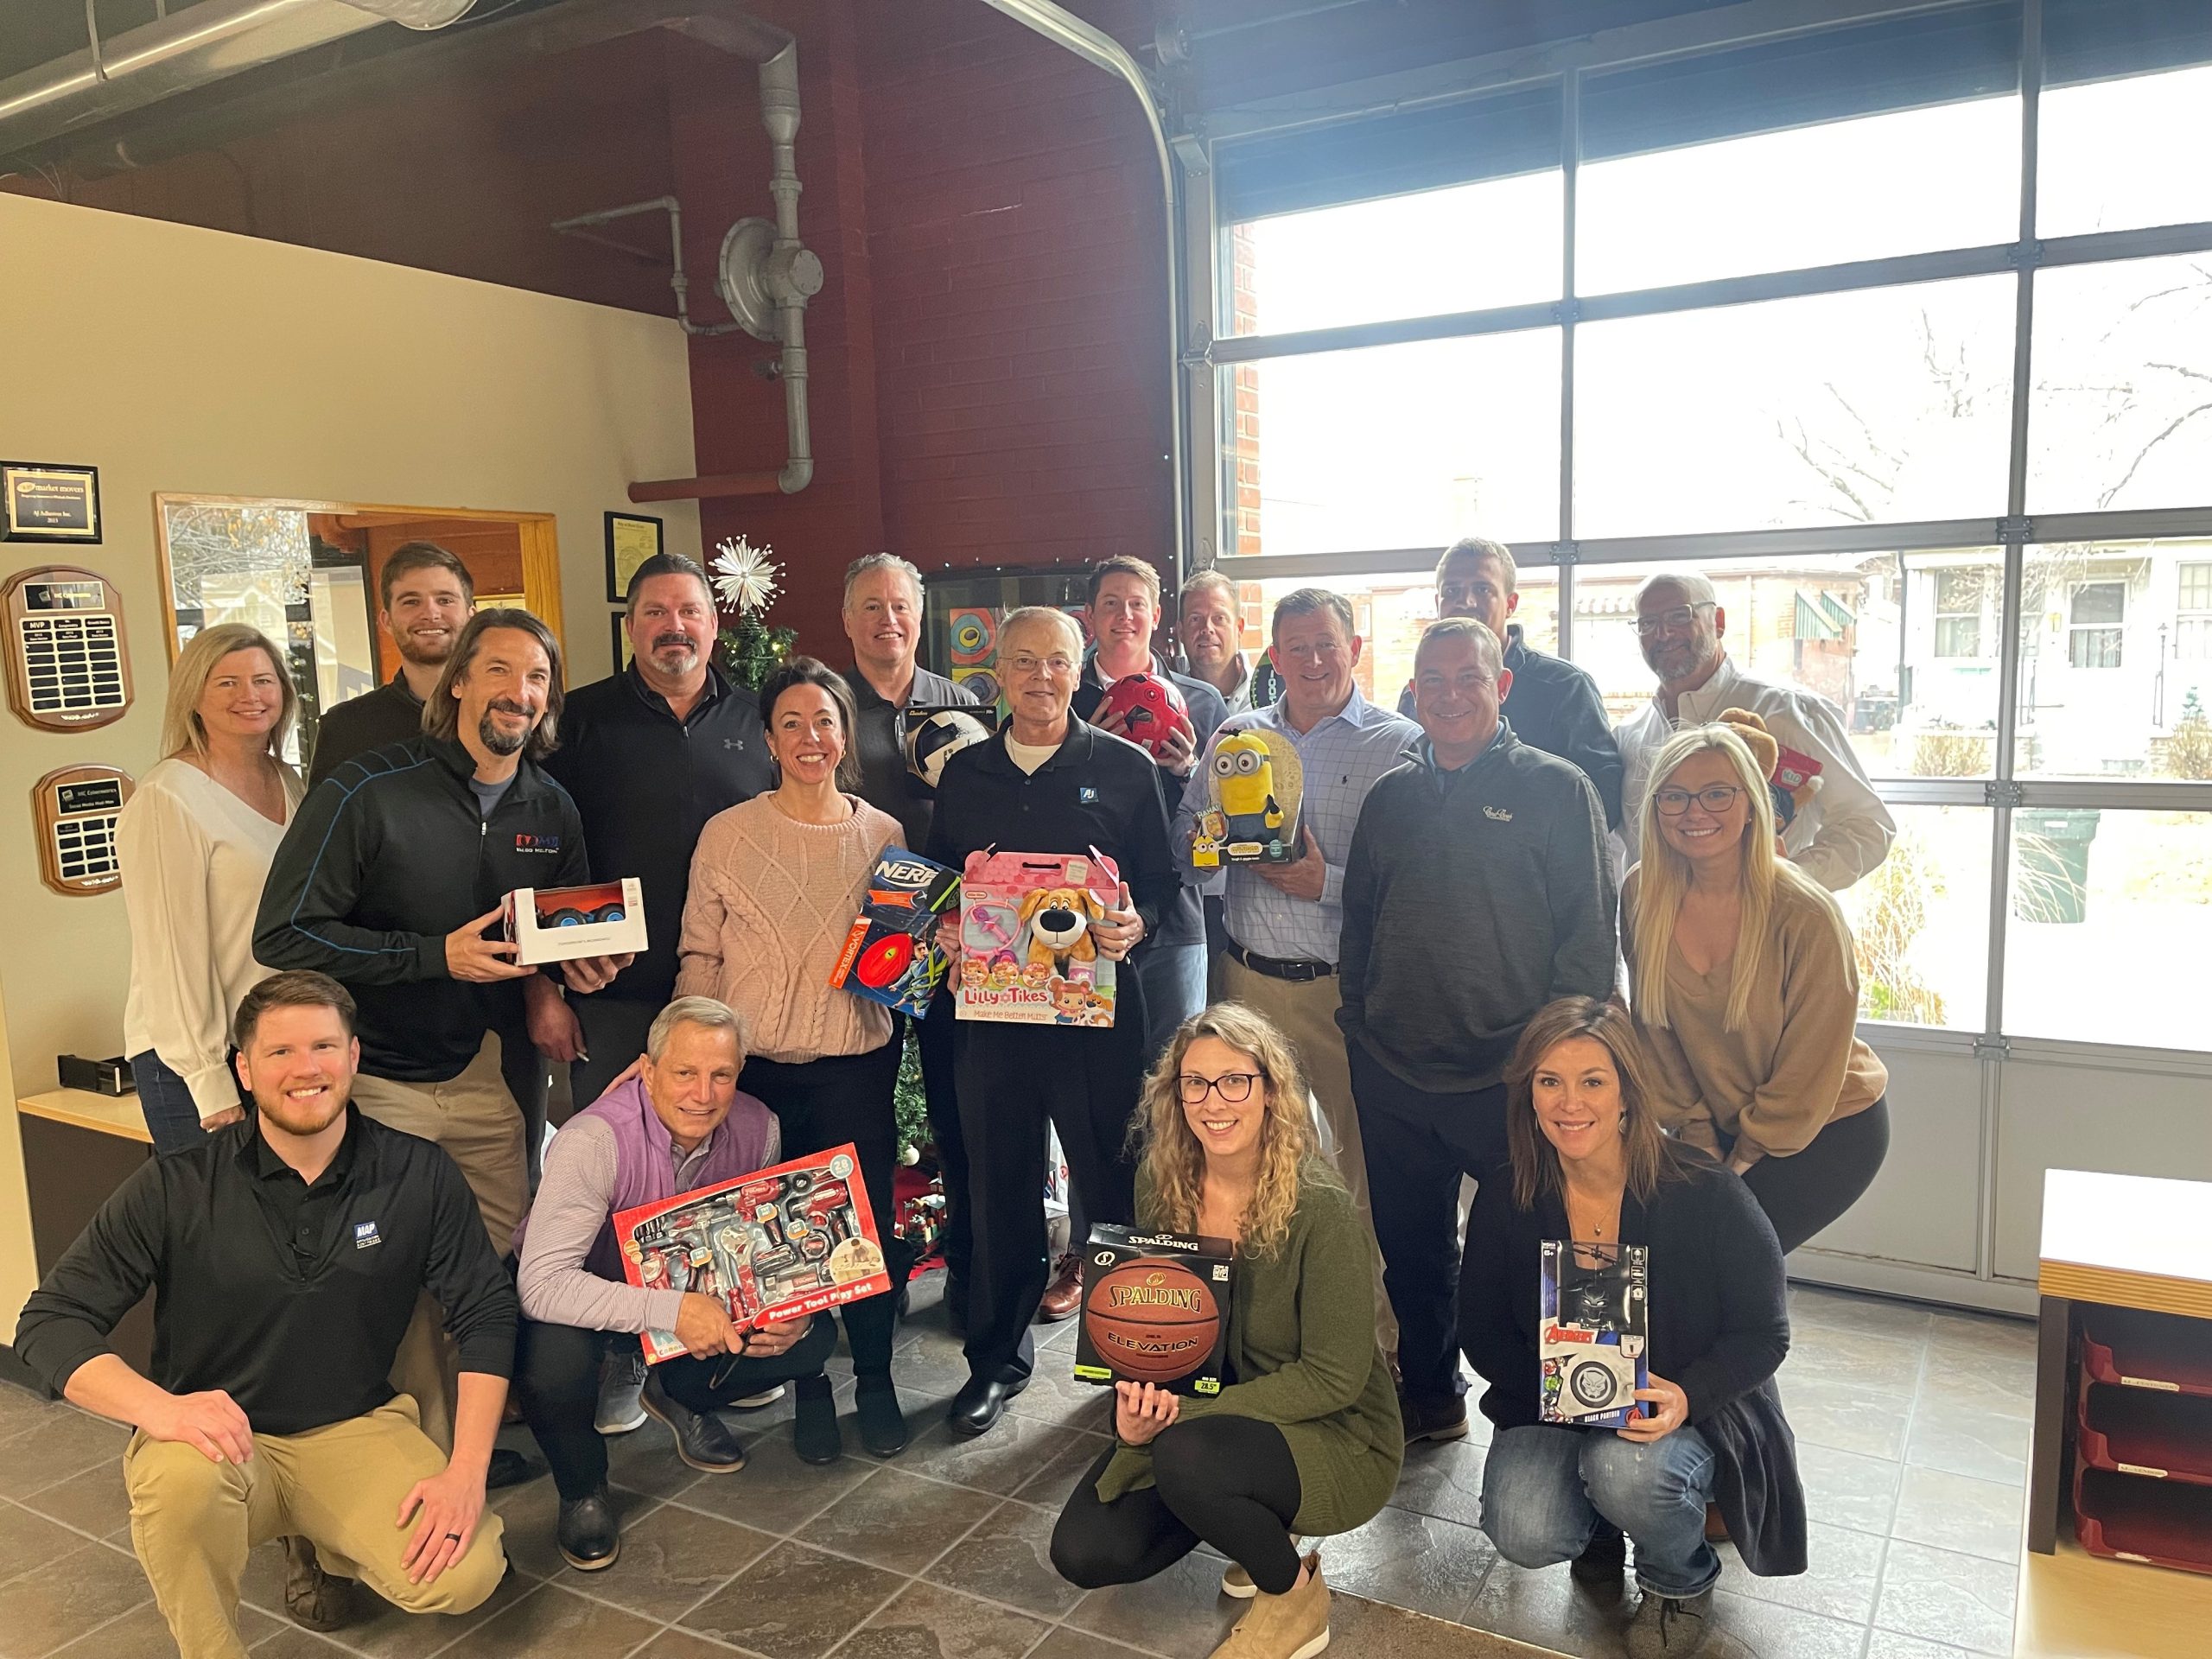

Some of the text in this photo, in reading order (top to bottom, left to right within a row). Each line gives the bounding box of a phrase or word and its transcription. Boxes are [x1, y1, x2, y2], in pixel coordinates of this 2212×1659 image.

[1083, 789, 1095, 799] AJ
[874, 861, 939, 884] NERF
[840, 935, 861, 969] VORTEX
[964, 987, 1048, 1005] Lilly Tikes
[833, 1159, 849, 1170] 28
[1128, 1236, 1199, 1251] SPALDING
[769, 1305, 802, 1320] Power
[804, 1296, 829, 1310] Tool
[854, 1283, 873, 1295] Set
[1109, 1284, 1202, 1314] SPALDING
[1108, 1332, 1198, 1353] ELEVATION
